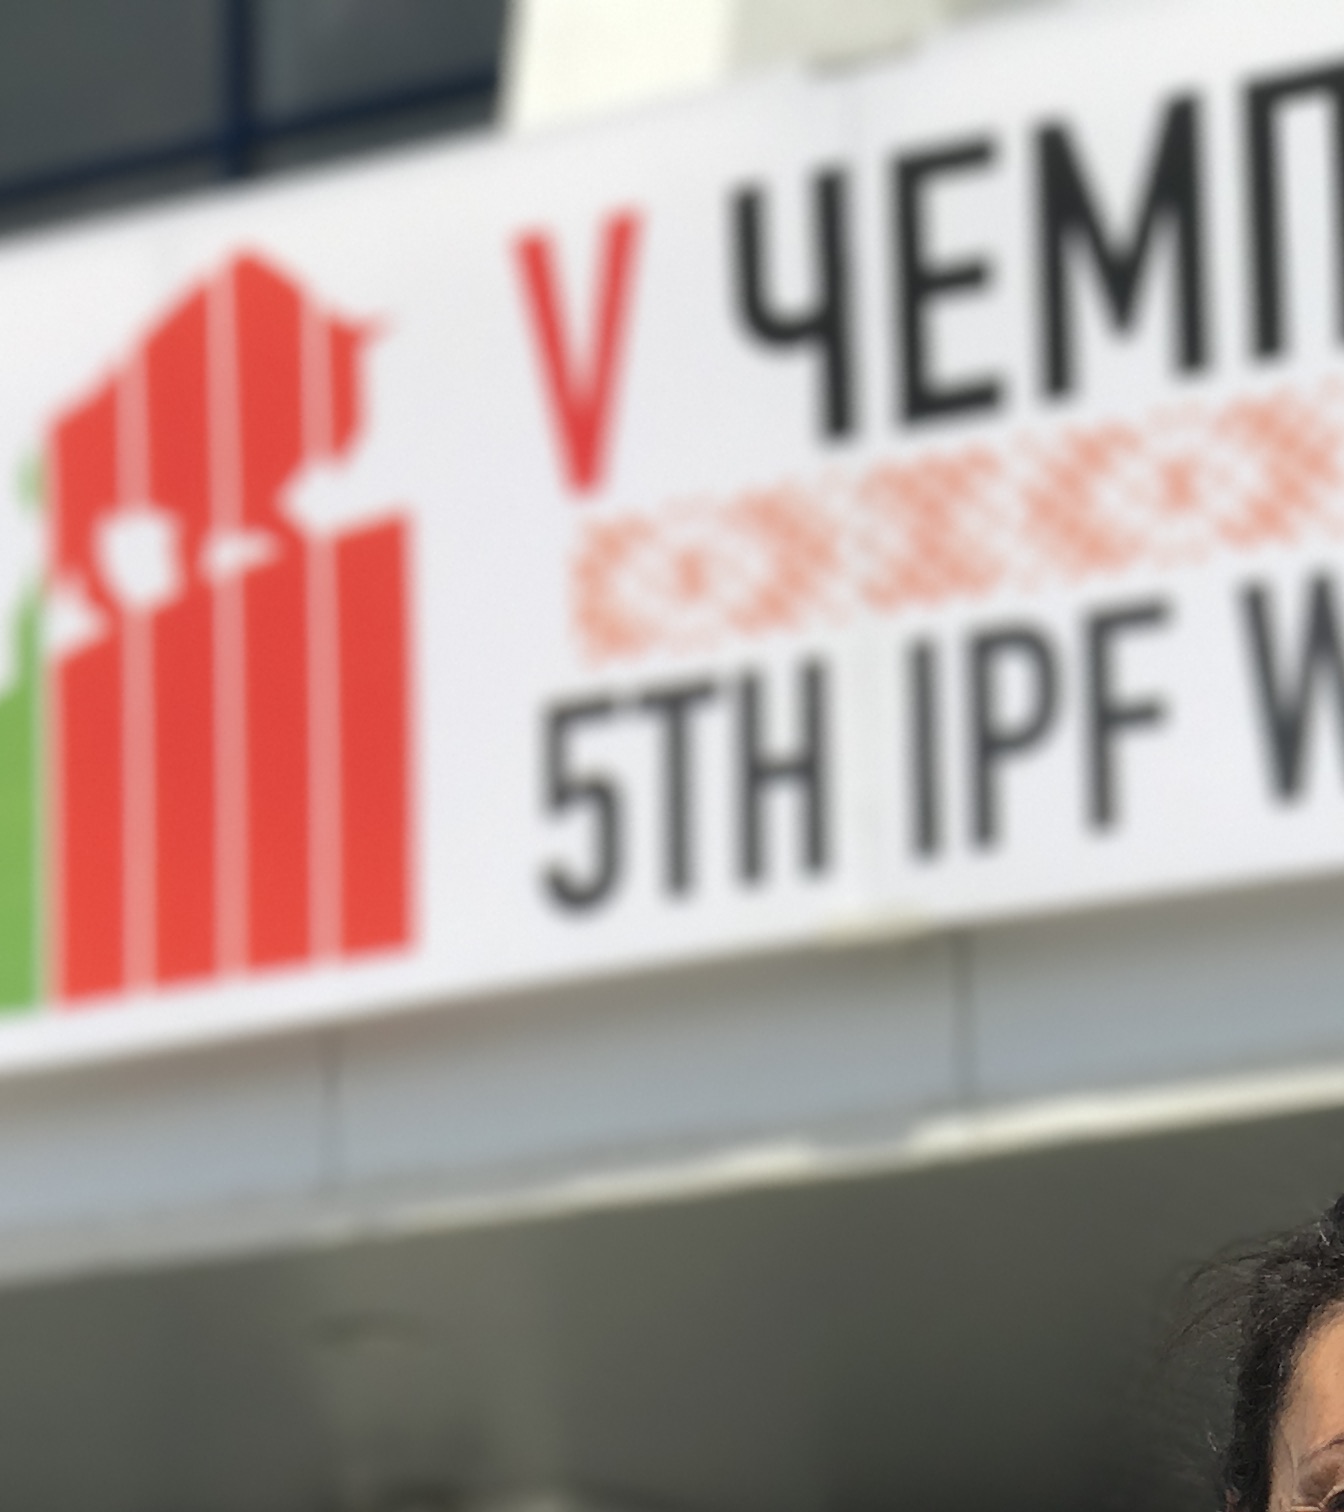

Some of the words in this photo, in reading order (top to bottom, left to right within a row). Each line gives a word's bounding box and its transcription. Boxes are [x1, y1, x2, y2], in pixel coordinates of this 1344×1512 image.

[512, 203, 641, 498] V
[540, 563, 831, 918] 5TH
[907, 595, 1173, 862] IPF
